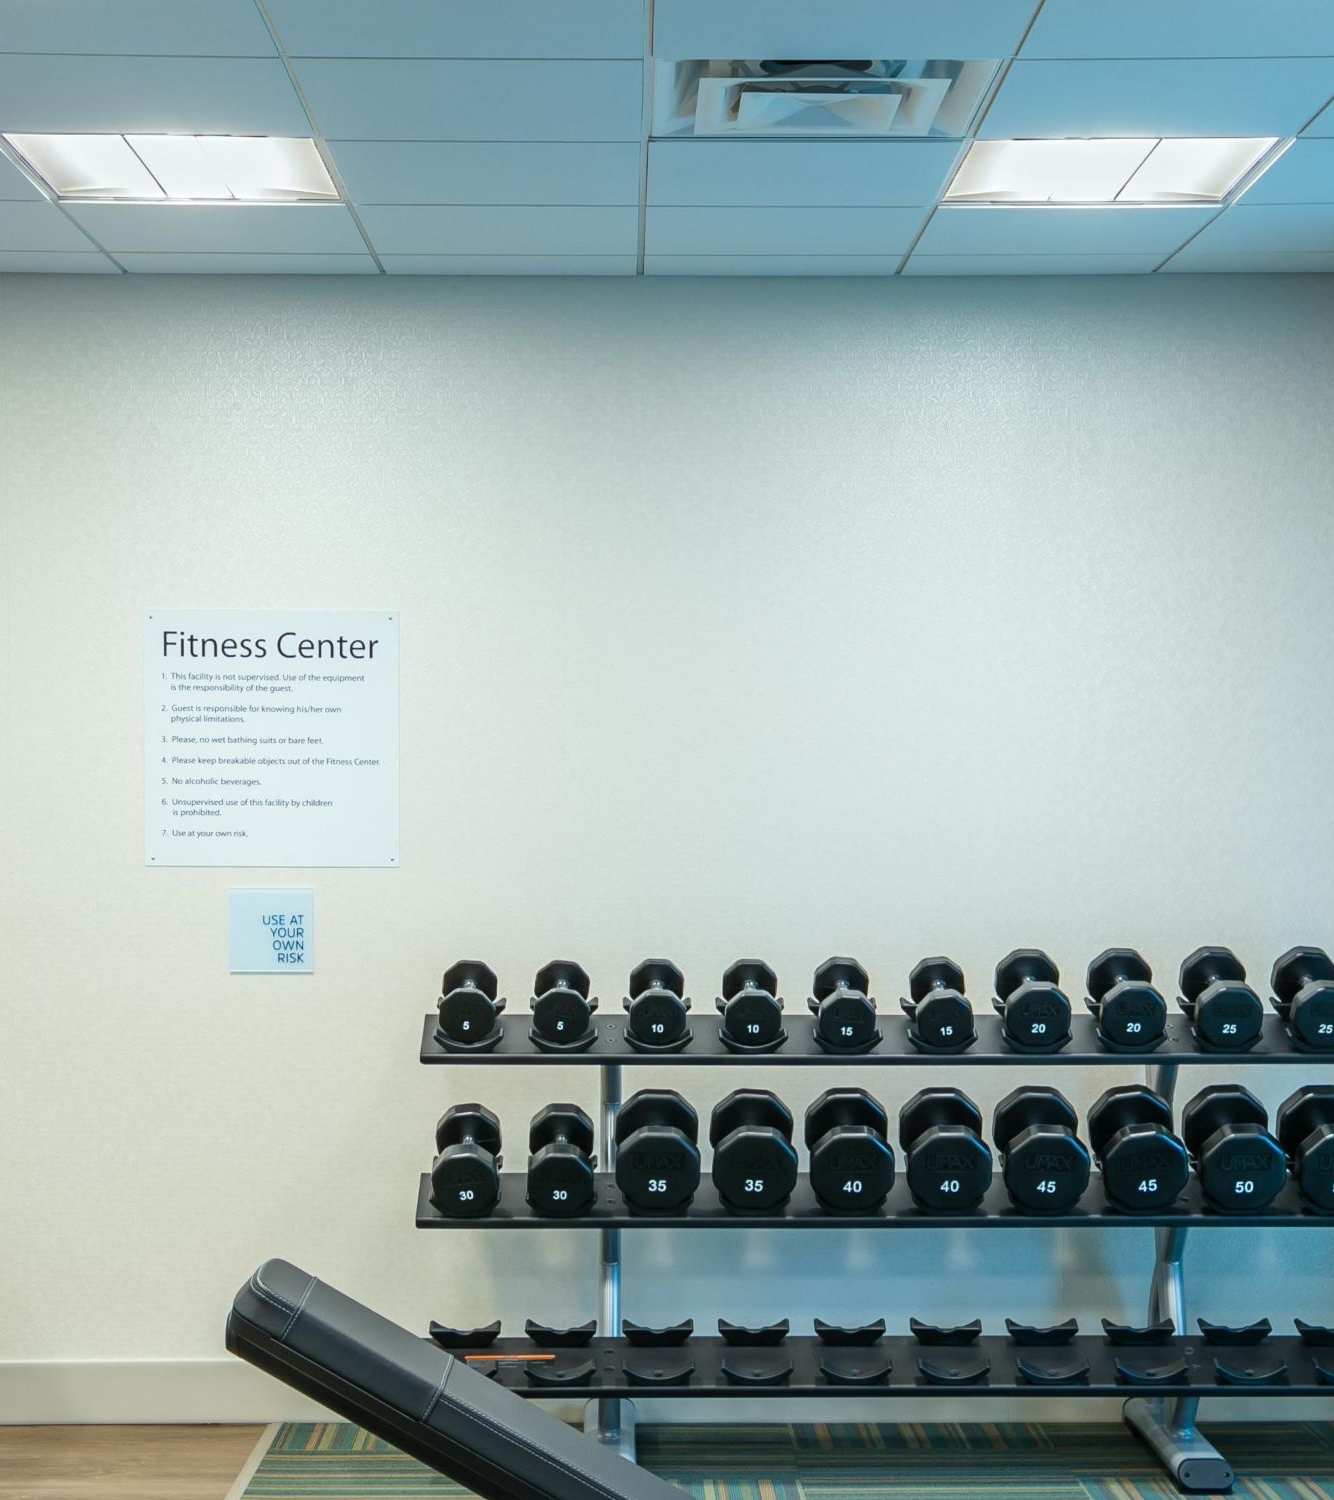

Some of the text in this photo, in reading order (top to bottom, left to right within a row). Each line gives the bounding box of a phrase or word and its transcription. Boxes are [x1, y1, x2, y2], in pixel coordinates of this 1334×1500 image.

[163, 631, 379, 659] Fitness Center
[170, 672, 186, 680] This
[188, 671, 213, 681] facility
[282, 673, 296, 681] Use
[298, 673, 307, 681] of
[307, 673, 320, 681] the
[322, 674, 364, 683] equipment
[170, 683, 176, 691] is
[178, 683, 191, 691] the
[192, 683, 244, 693] responsibility
[245, 683, 254, 691] of
[171, 704, 193, 712] Guest
[195, 704, 201, 712] is
[203, 704, 247, 714] responsible
[248, 704, 259, 712] for
[261, 705, 295, 714] knowing
[296, 705, 323, 713] his/her
[170, 714, 201, 724] physical
[227, 735, 257, 745] bathing
[259, 736, 276, 744] suits
[287, 736, 305, 744] bare
[171, 756, 196, 764] Please
[197, 756, 216, 765] keep
[218, 756, 256, 764] breakable
[257, 757, 285, 766] objects
[301, 757, 310, 765] of
[311, 757, 324, 765] the
[326, 757, 352, 765] Fitness
[184, 777, 218, 785] alcoholic
[171, 797, 224, 807] Unsupervised
[239, 798, 248, 806] of
[249, 798, 263, 806] this
[264, 798, 289, 808] facility
[290, 799, 300, 808] by
[301, 799, 332, 807] children
[262, 914, 304, 925] USE AT
[269, 927, 304, 938] YOUR
[272, 939, 303, 950] OWN
[277, 952, 304, 963] RISK
[462, 1020, 470, 1031] 5
[556, 1021, 564, 1031] 5
[651, 1023, 664, 1034] 10
[747, 1024, 760, 1034] 10
[940, 1026, 953, 1036] 15
[1031, 1023, 1046, 1034] 20
[1126, 1022, 1142, 1033] 20
[1222, 1023, 1237, 1034] 25
[1318, 1023, 1334, 1034] 25
[840, 1026, 853, 1037] 15
[634, 1153, 684, 1170] UMAX
[828, 1154, 876, 1170] UMAX
[924, 1153, 974, 1170] UMAX
[1024, 1153, 1073, 1171] UMAX
[1221, 1154, 1269, 1170] UMAX
[648, 1179, 667, 1193] 35
[744, 1179, 764, 1193] 35
[842, 1180, 862, 1193] 40
[940, 1180, 960, 1193] 40
[1036, 1180, 1056, 1194] 45
[1138, 1179, 1158, 1193] 45
[1235, 1180, 1254, 1194] 50
[459, 1190, 474, 1201] 30
[552, 1190, 568, 1200] 30
